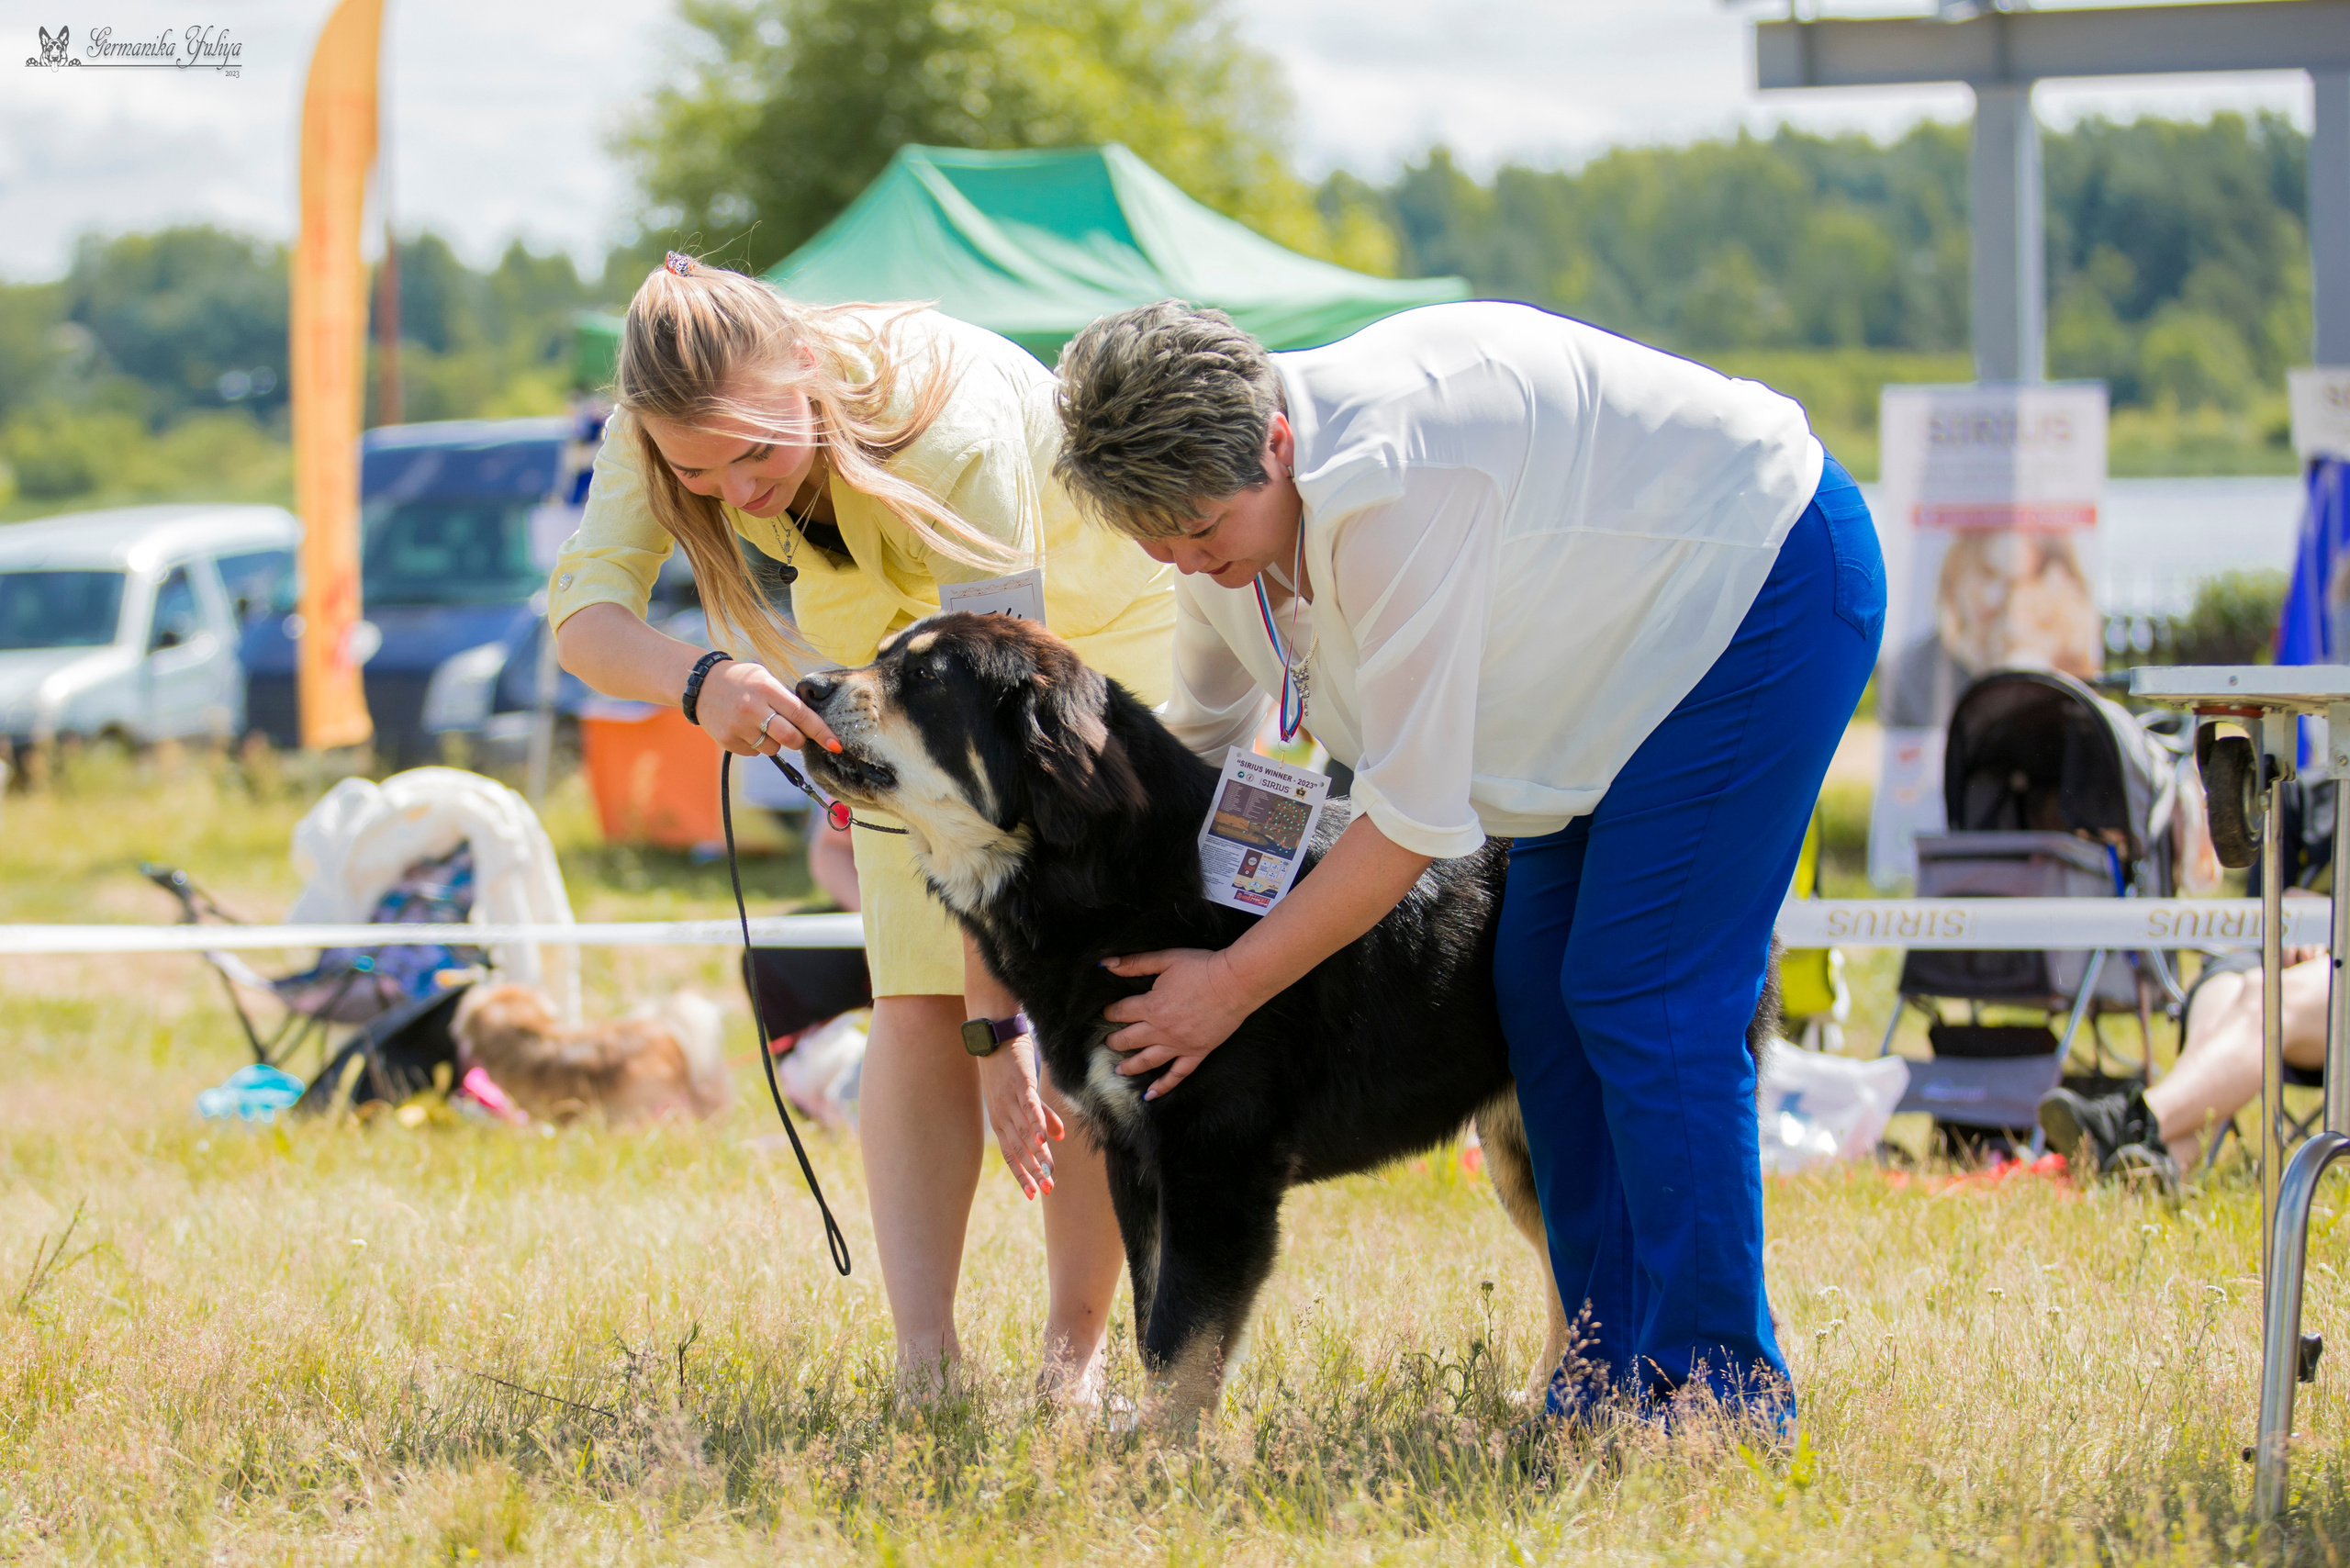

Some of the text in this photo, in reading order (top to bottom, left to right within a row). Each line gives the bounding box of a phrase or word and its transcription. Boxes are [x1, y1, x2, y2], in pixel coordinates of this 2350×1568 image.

[1264, 767, 1292, 782] WINNER
[1261, 778, 1290, 793] SIRIUS
[1827, 908, 1966, 938] SIRIUS
